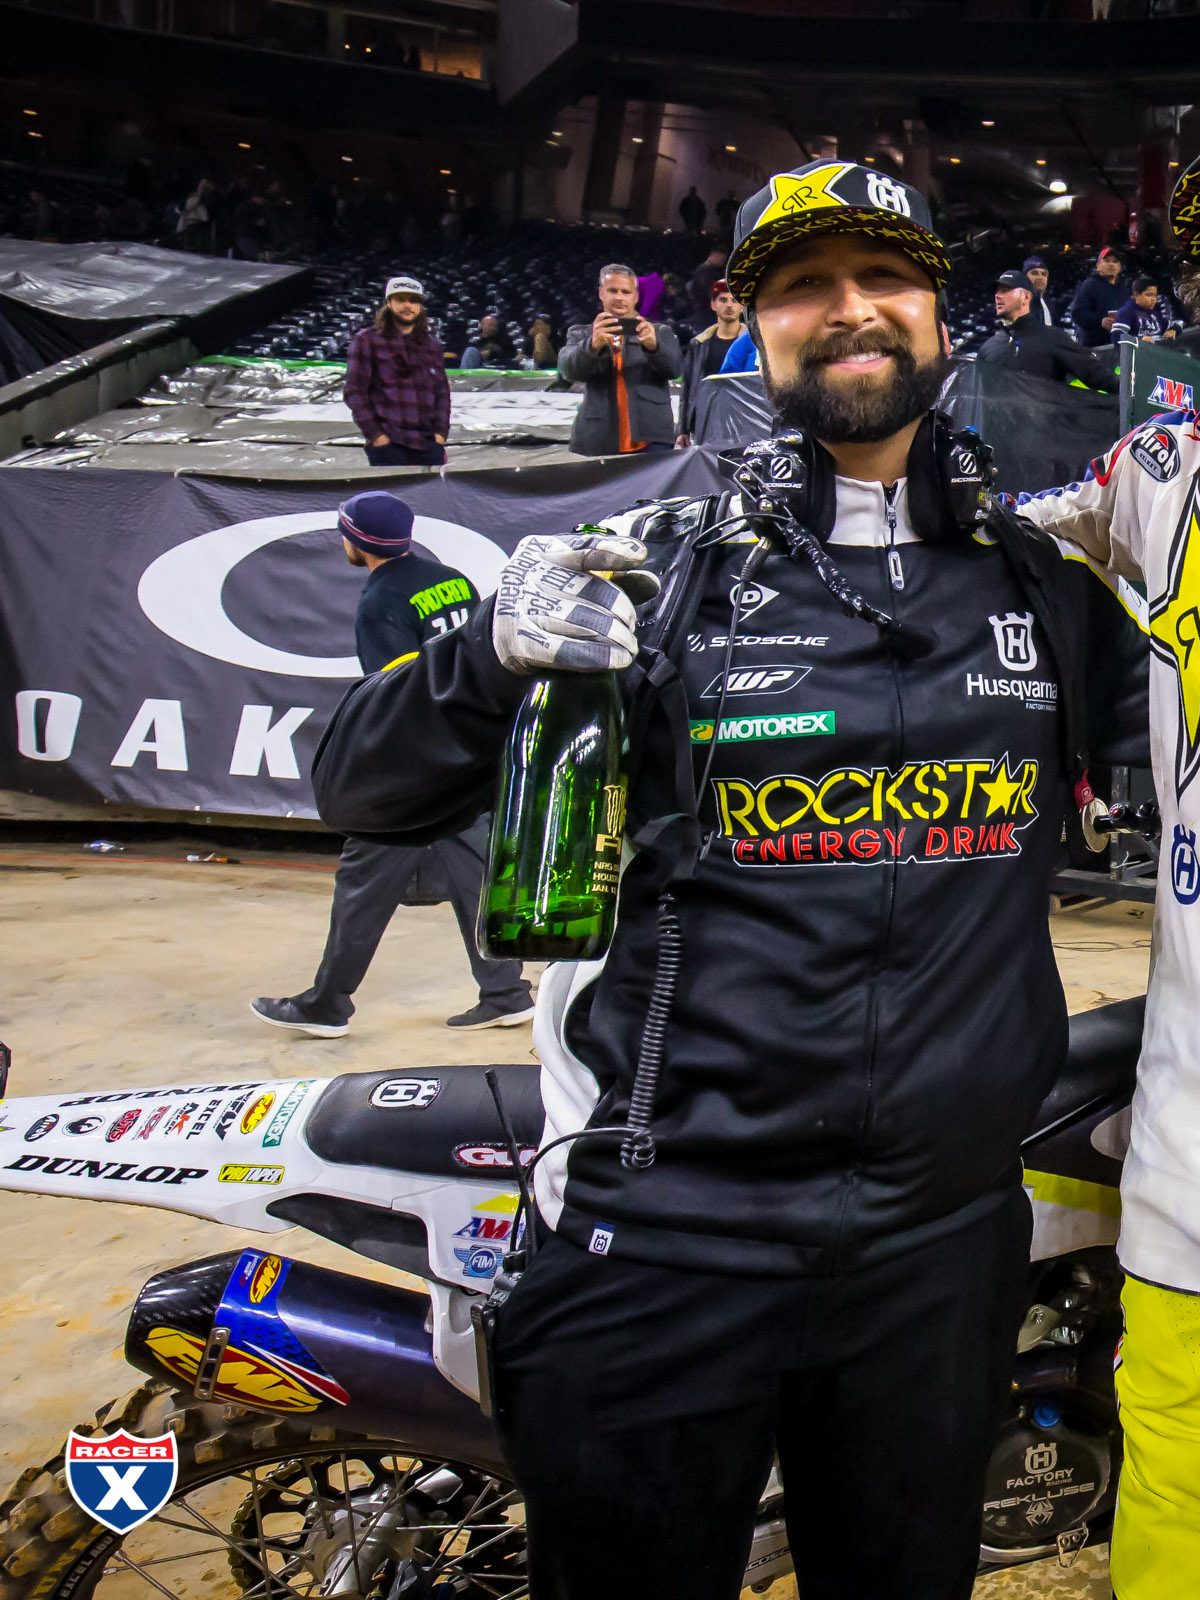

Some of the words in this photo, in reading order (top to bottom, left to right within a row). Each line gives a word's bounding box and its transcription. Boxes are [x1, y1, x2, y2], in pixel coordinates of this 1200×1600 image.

[1148, 375, 1194, 410] AMA
[708, 635, 830, 648] SCOSCHE
[966, 672, 1058, 701] Husqvarna
[717, 713, 830, 741] MOTOREX
[736, 826, 907, 861] ENERGY
[925, 821, 1018, 857] DRINK
[186, 1099, 224, 1140] EXCEL
[2, 1154, 209, 1185] DUNLOP
[471, 1255, 494, 1269] FIM
[1006, 1467, 1075, 1490] FACTORY
[983, 1482, 1095, 1512] REKLUSE
